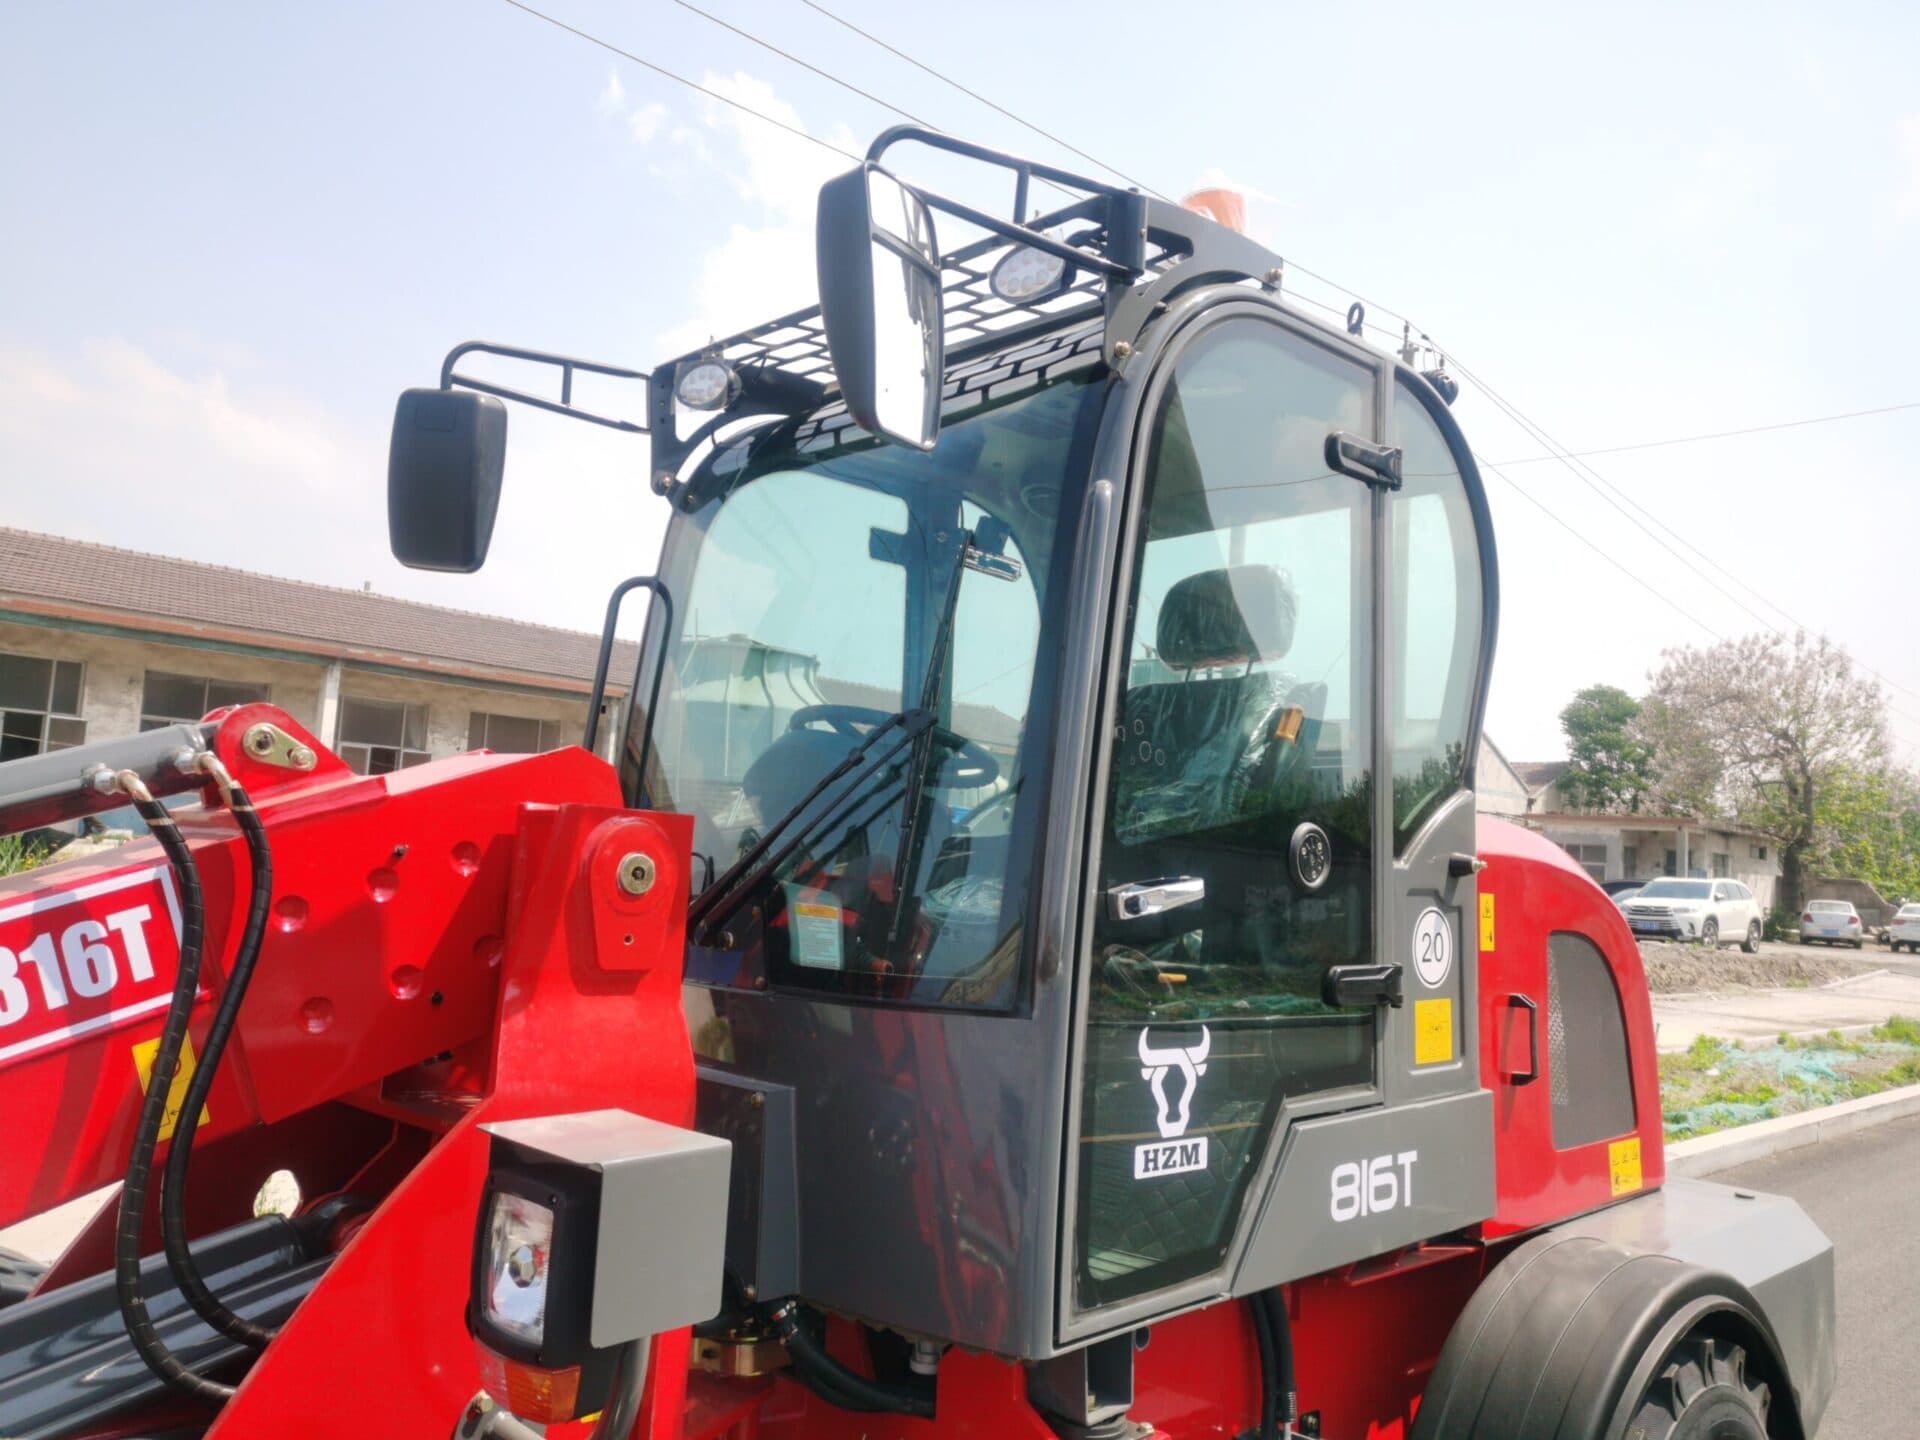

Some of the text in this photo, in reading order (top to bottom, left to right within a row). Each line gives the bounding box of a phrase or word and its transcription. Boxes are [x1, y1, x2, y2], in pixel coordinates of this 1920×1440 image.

[1421, 932, 1445, 963] 20
[1143, 1143, 1201, 1173] HZM
[1331, 1150, 1418, 1223] 816T
